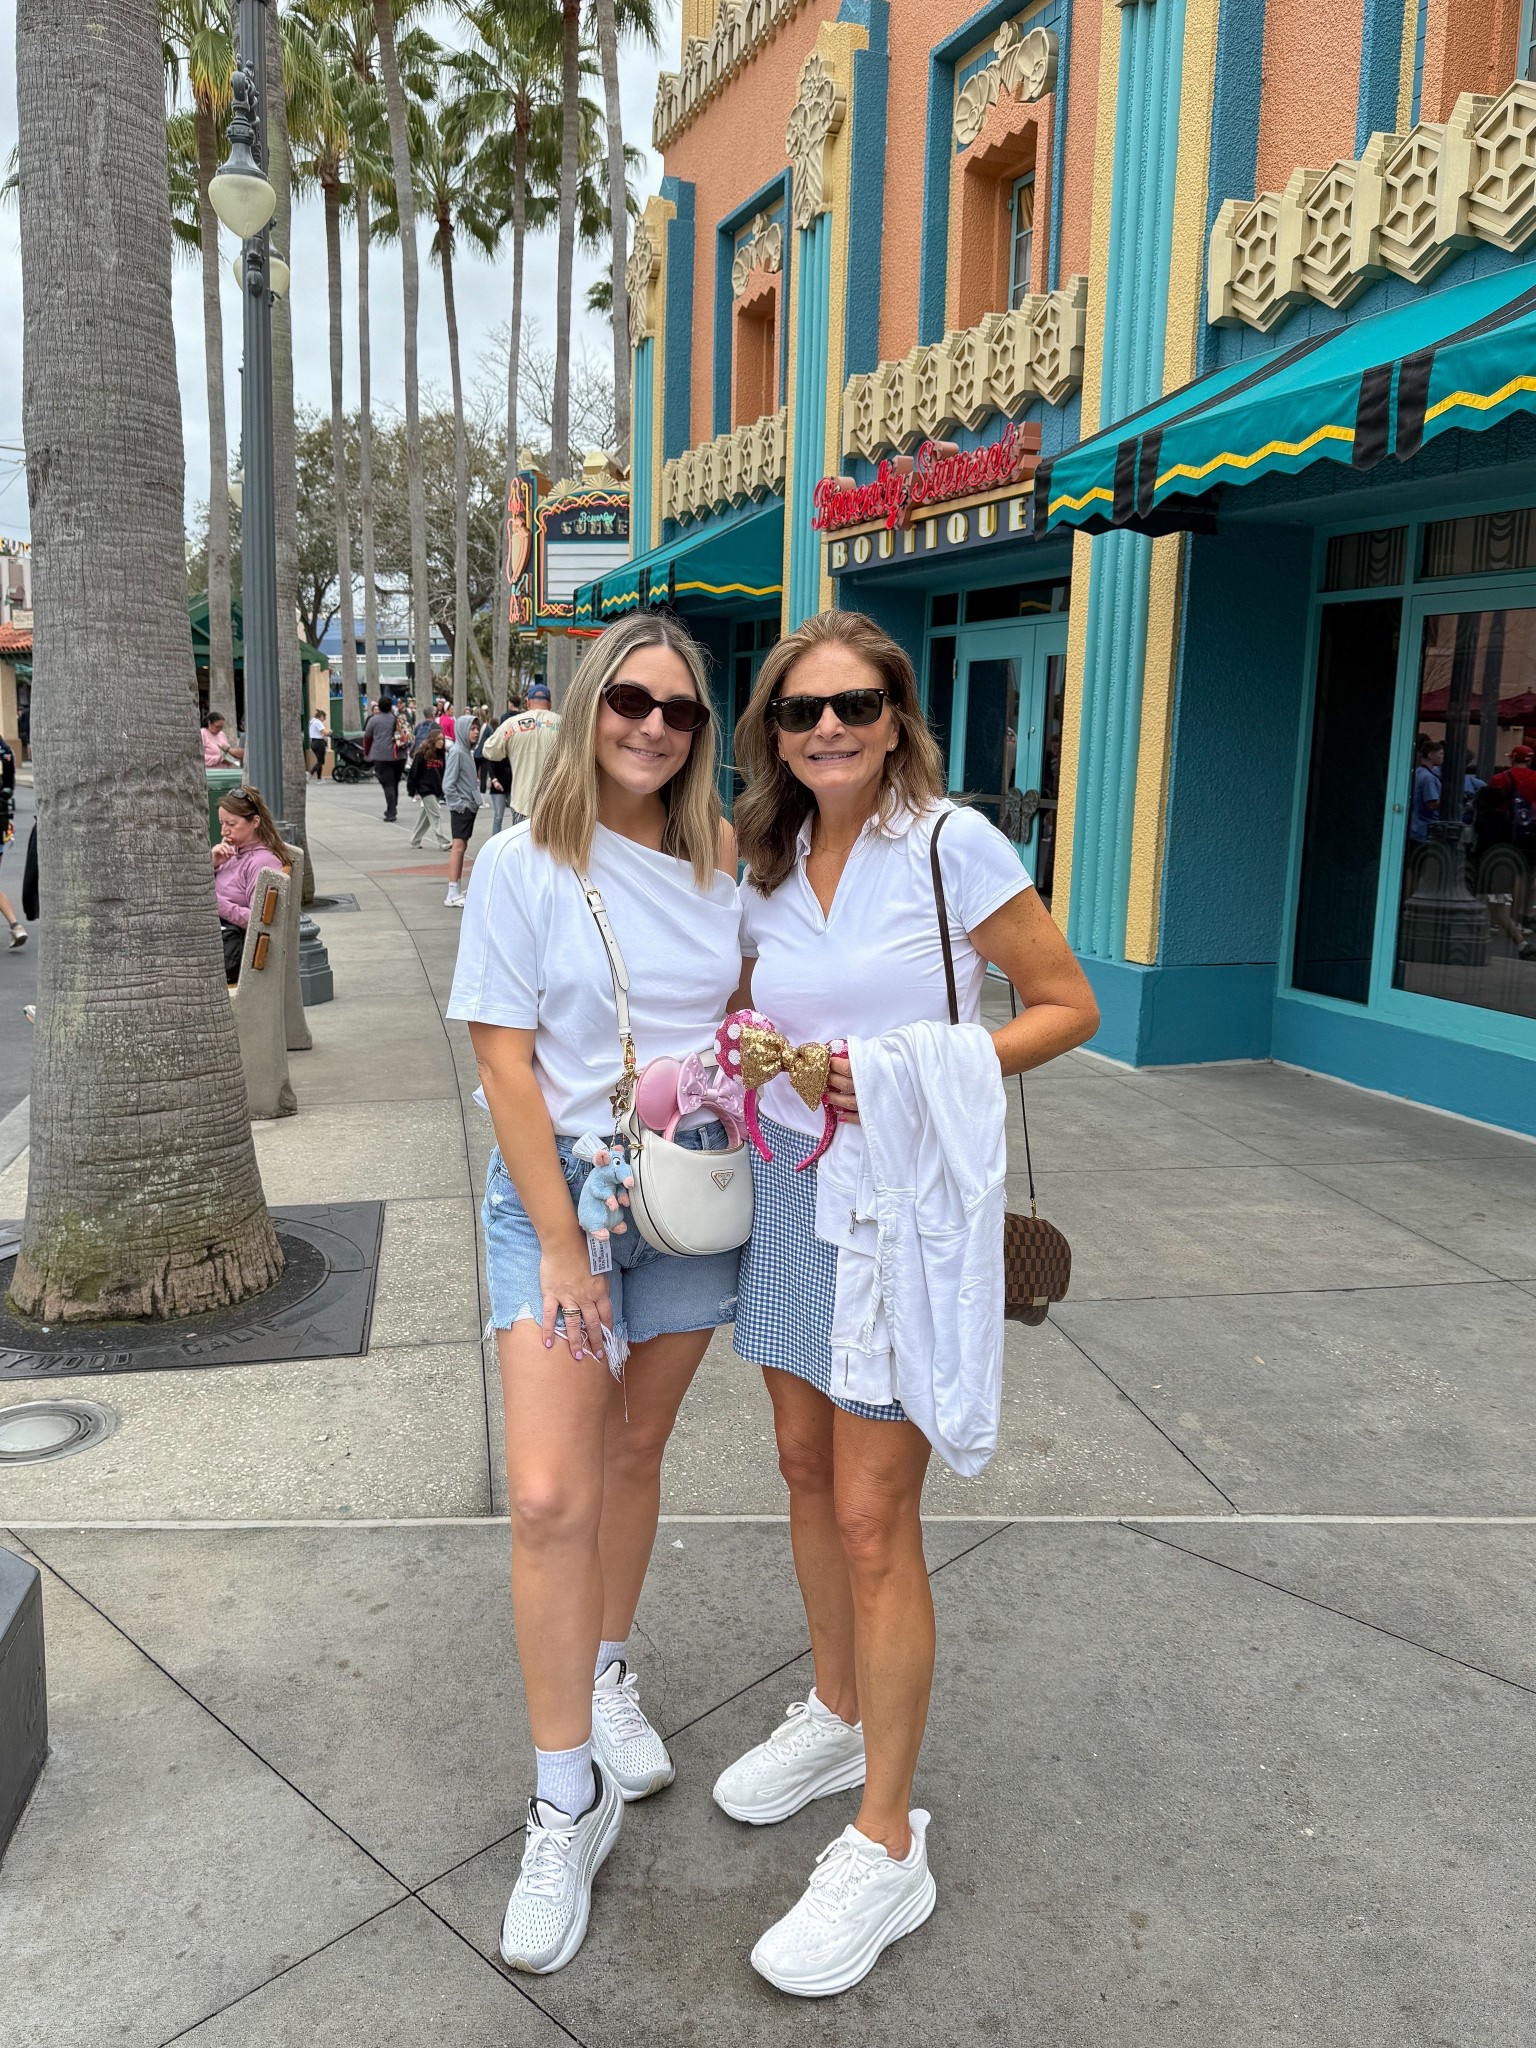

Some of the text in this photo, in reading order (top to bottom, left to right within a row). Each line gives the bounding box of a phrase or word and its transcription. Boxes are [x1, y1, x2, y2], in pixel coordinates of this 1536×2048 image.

[811, 421, 1017, 530] Beverly Sunset
[579, 511, 617, 525] Beverly
[831, 497, 1027, 570] BOUTIQUE
[0, 1352, 132, 1370] YWOOD
